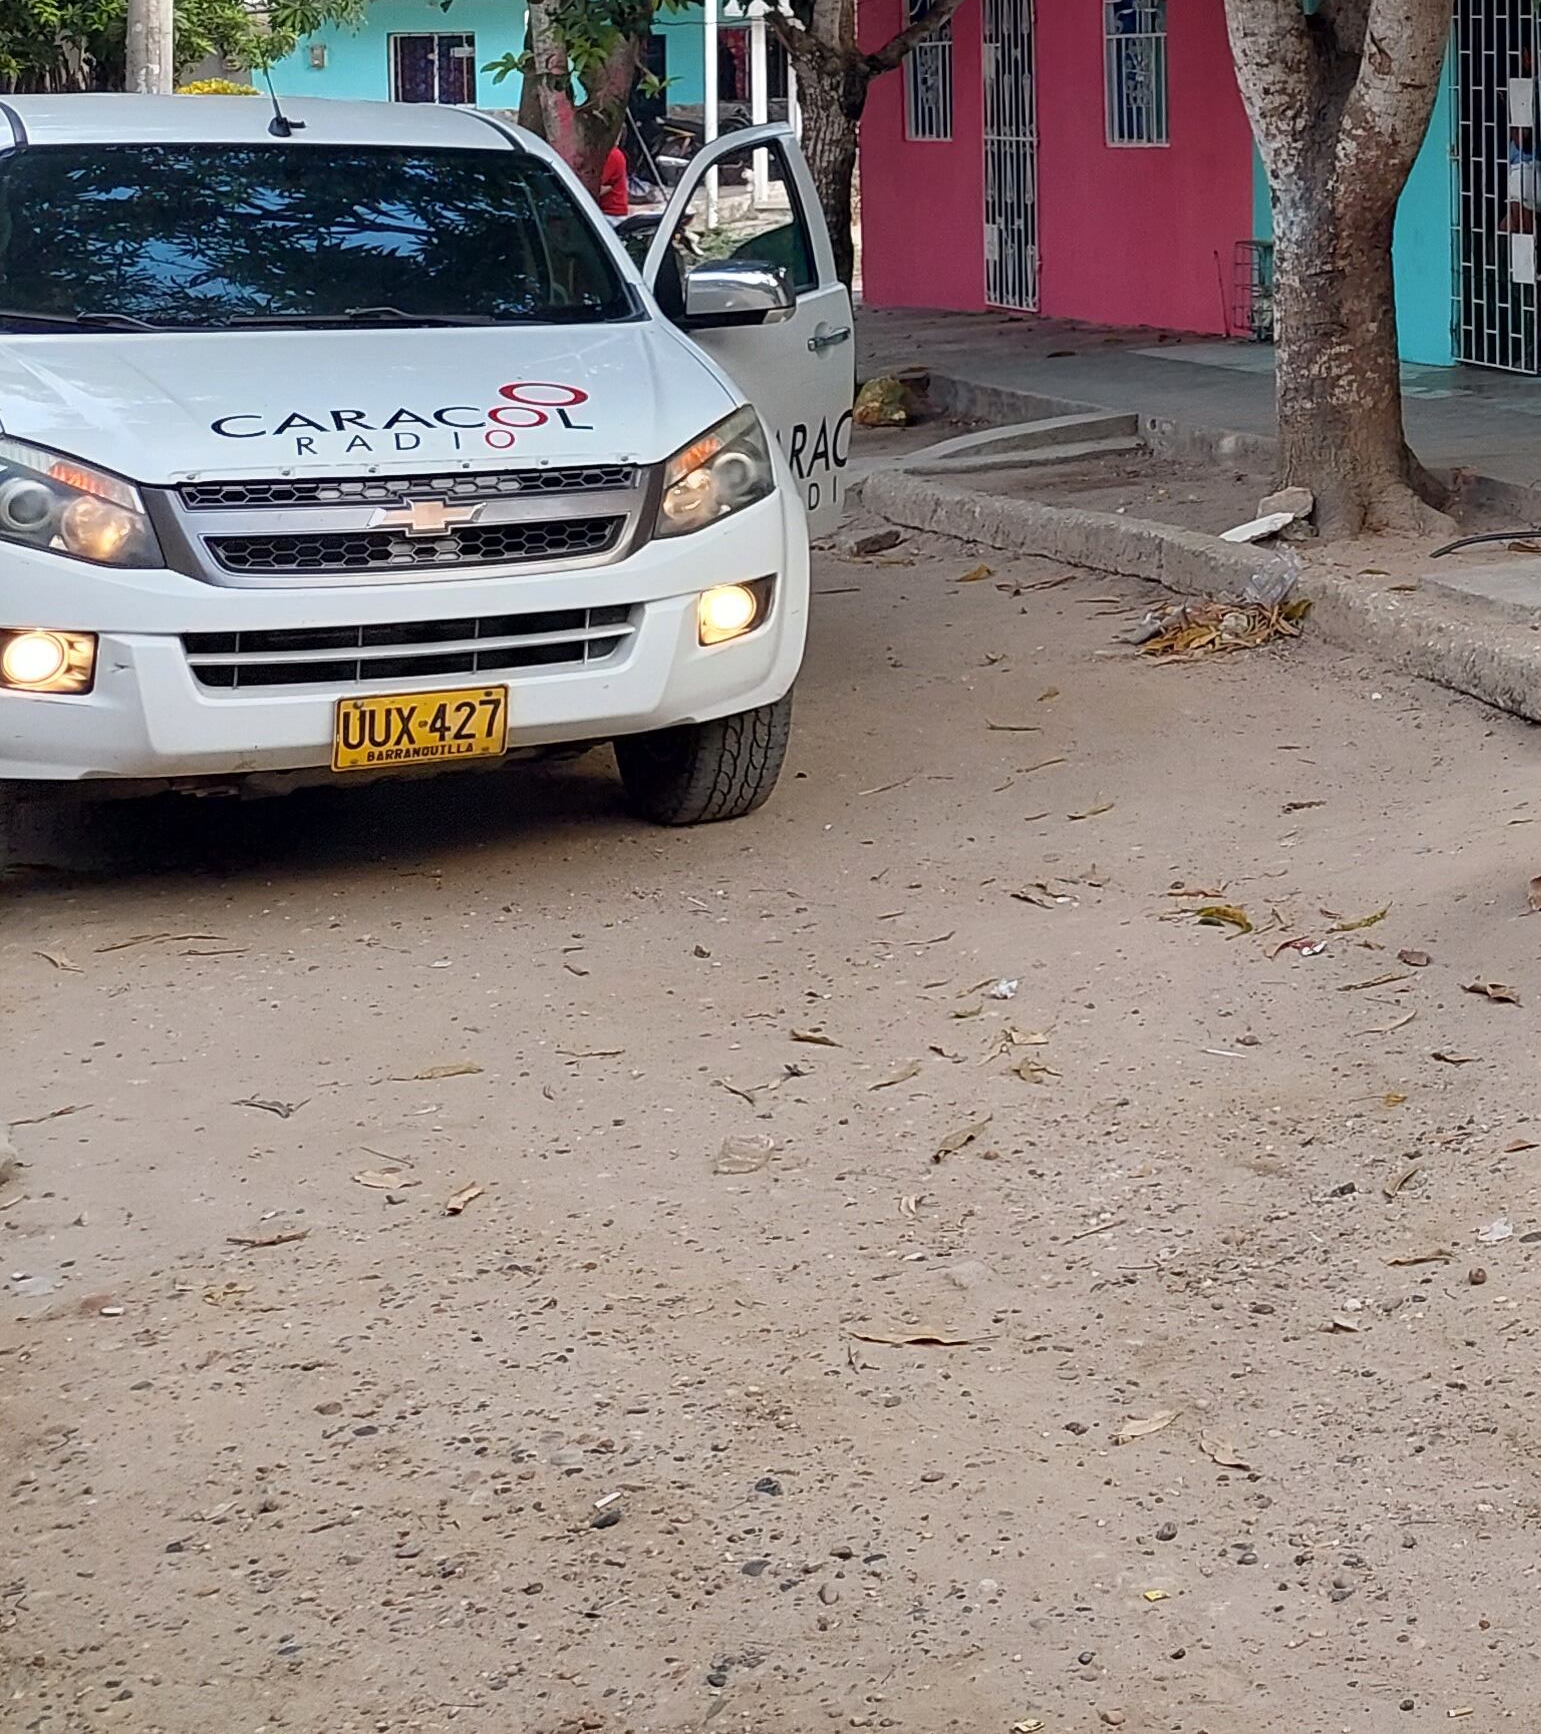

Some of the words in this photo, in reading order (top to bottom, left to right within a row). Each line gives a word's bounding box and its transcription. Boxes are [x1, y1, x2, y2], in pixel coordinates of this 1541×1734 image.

[210, 406, 594, 437] CARACOL
[295, 429, 516, 455] RADIO
[776, 408, 854, 479] RAC
[366, 742, 474, 763] BARRANQUILLA
